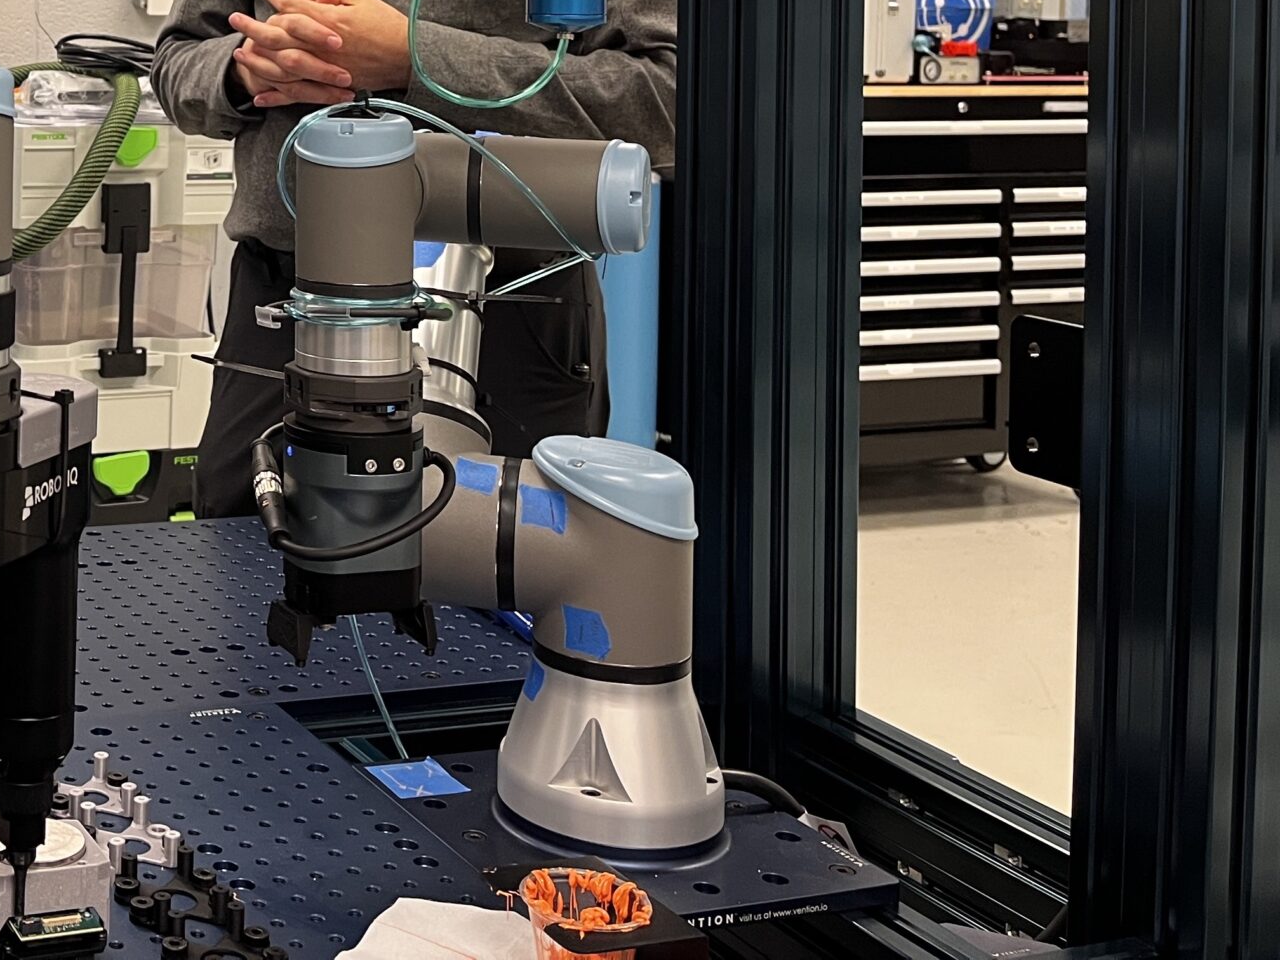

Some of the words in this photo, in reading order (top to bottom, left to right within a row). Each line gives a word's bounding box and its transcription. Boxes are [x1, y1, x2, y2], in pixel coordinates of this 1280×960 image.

[34, 465, 79, 504] ROBOIQ
[687, 913, 735, 928] NTION
[738, 912, 754, 922] visit
[754, 913, 763, 921] us
[773, 904, 828, 918] www.vention.io
